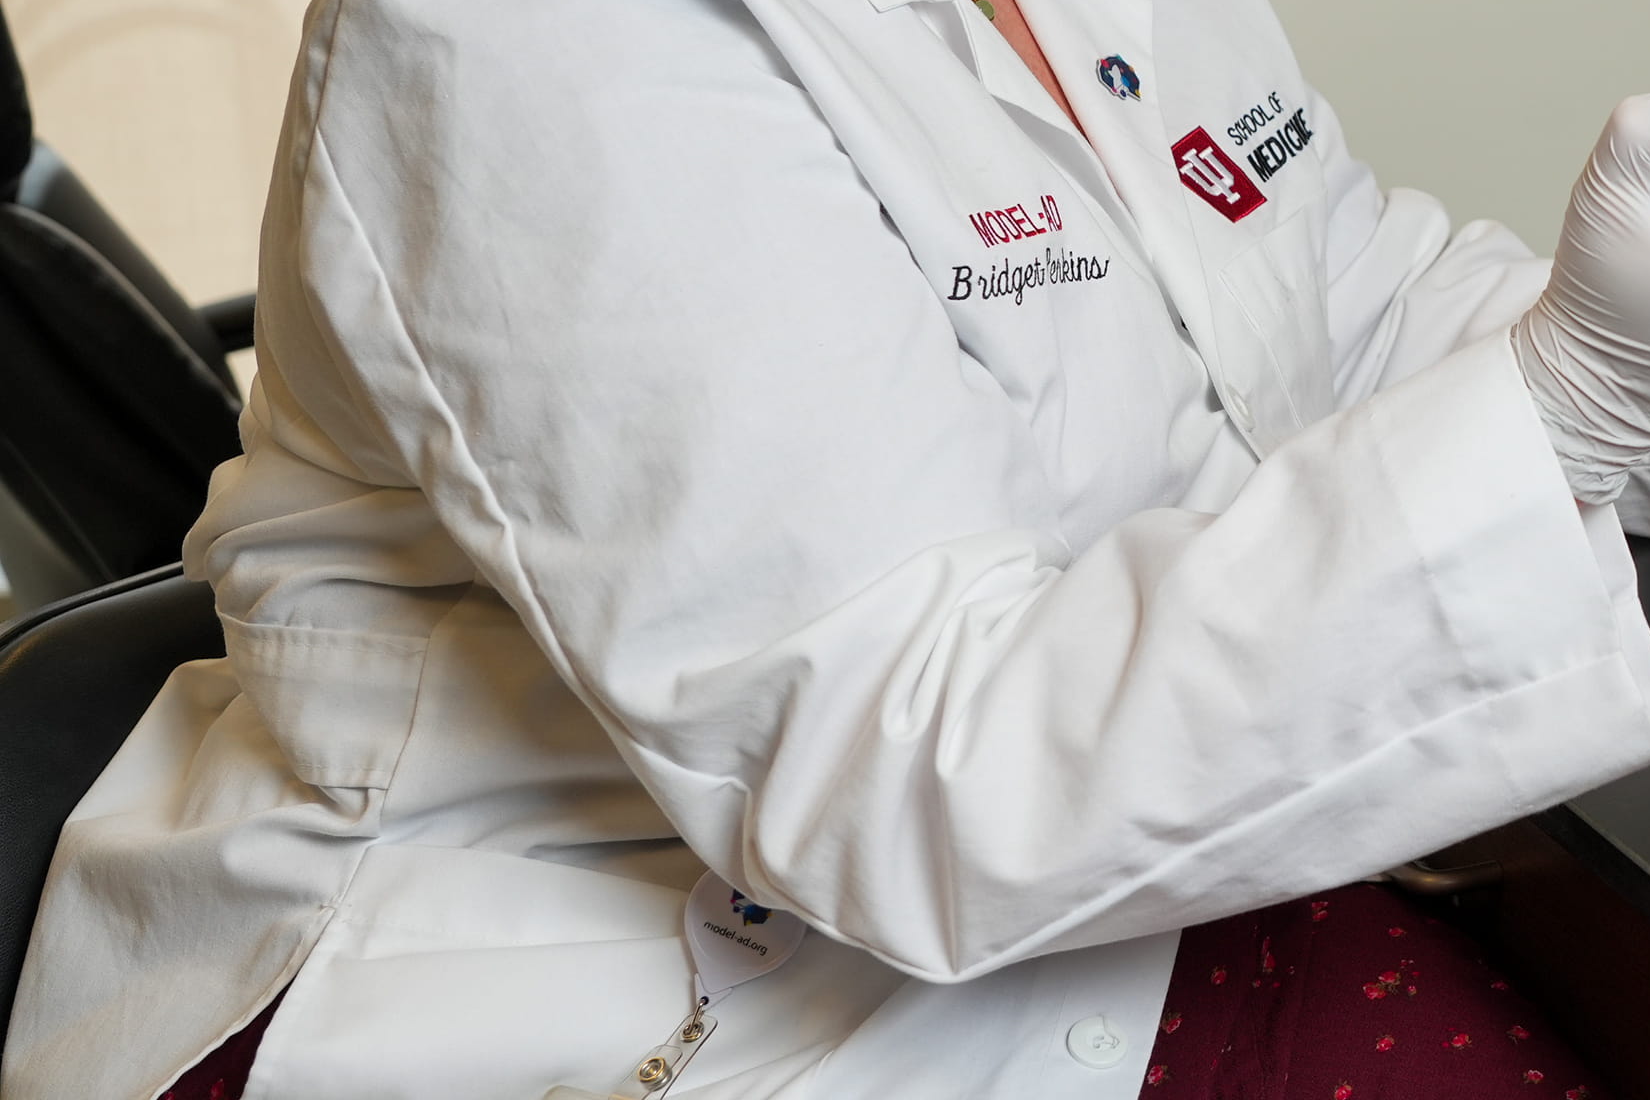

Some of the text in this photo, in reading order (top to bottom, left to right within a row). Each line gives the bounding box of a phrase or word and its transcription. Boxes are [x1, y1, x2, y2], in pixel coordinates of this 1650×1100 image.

[1227, 92, 1284, 146] SCHOOL OF
[1246, 108, 1314, 183] MEDICINE
[948, 244, 1111, 306] Bridget Perkins
[704, 922, 768, 956] model-ad.org
